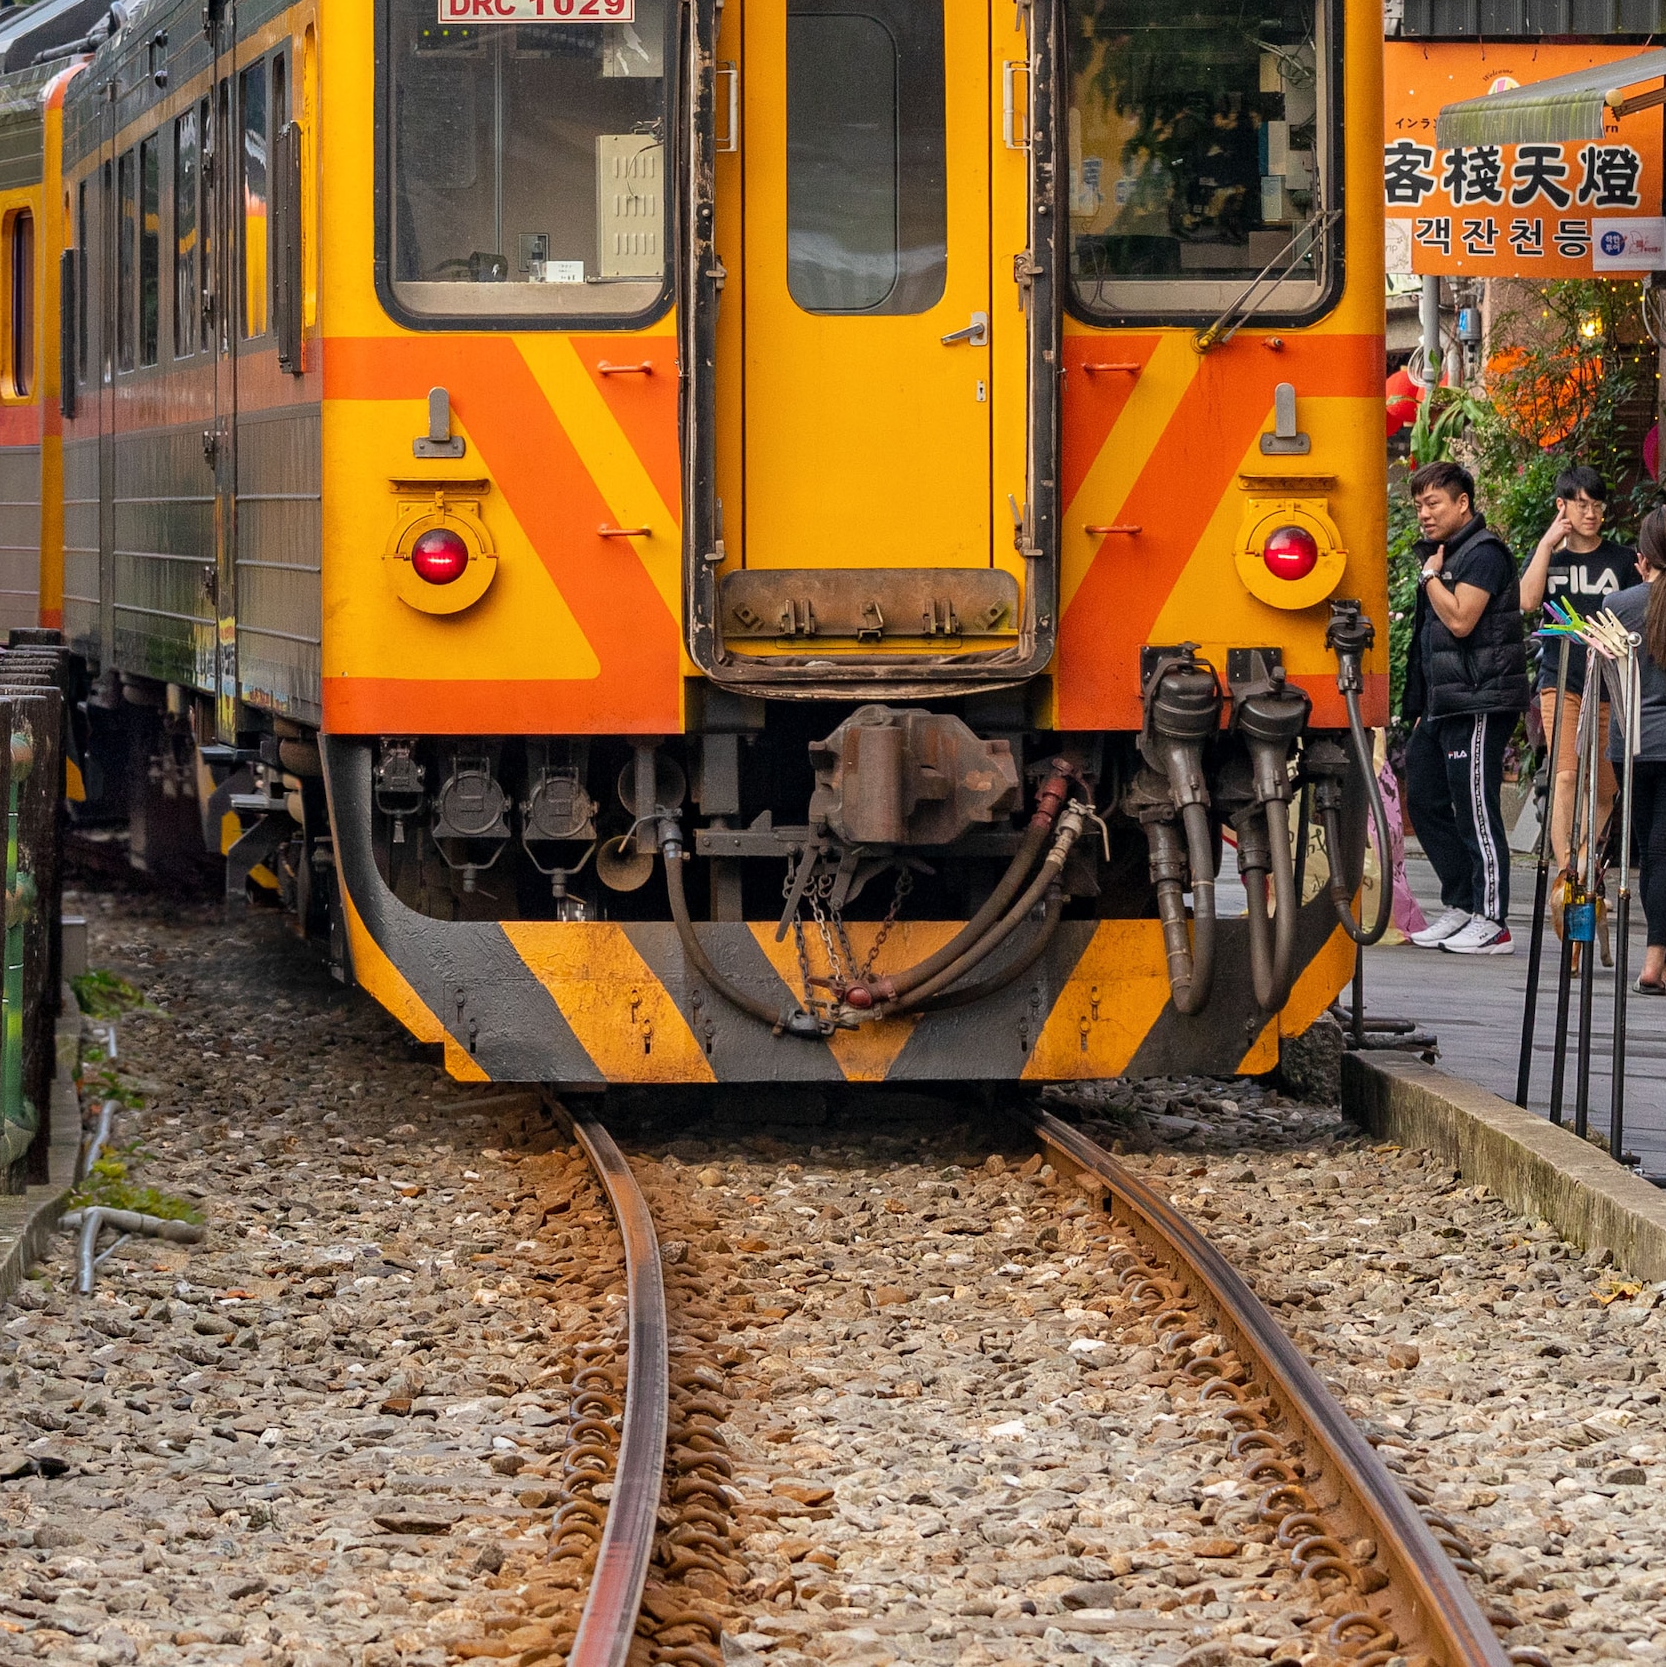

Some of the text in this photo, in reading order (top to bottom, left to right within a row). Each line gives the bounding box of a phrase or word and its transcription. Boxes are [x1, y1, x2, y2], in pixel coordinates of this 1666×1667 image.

[1384, 141, 1640, 209] 客棧天燈
[1415, 217, 1593, 258] 객잔천등
[1547, 564, 1620, 595] FILA
[1447, 749, 1468, 759] FILA
